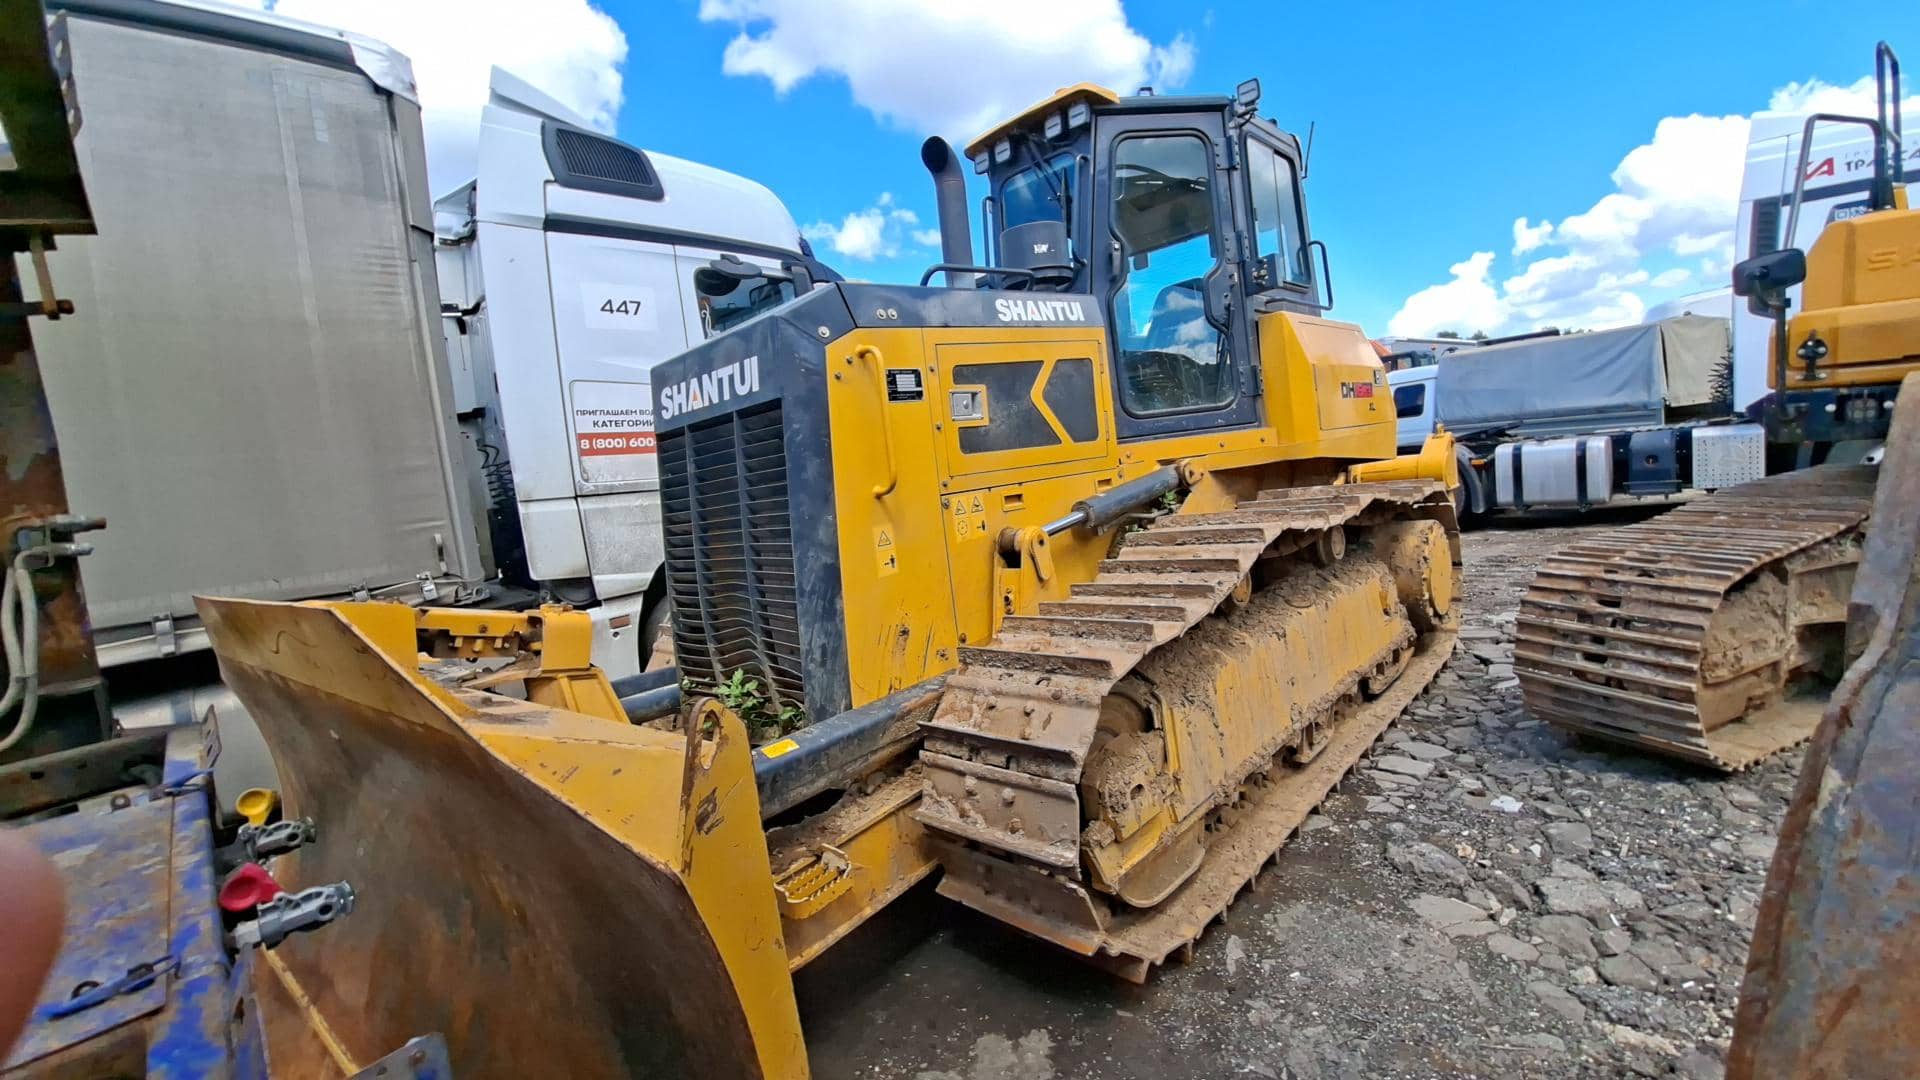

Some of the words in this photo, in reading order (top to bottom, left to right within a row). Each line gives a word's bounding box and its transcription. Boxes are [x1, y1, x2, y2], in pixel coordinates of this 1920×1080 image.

[599, 298, 641, 316] 447
[995, 298, 1085, 321] SHANTUI
[660, 355, 760, 420] SHANTUI
[576, 409, 637, 417] ПРИГЛАШАЕМ
[580, 438, 590, 450] 8
[593, 437, 627, 450] (800)
